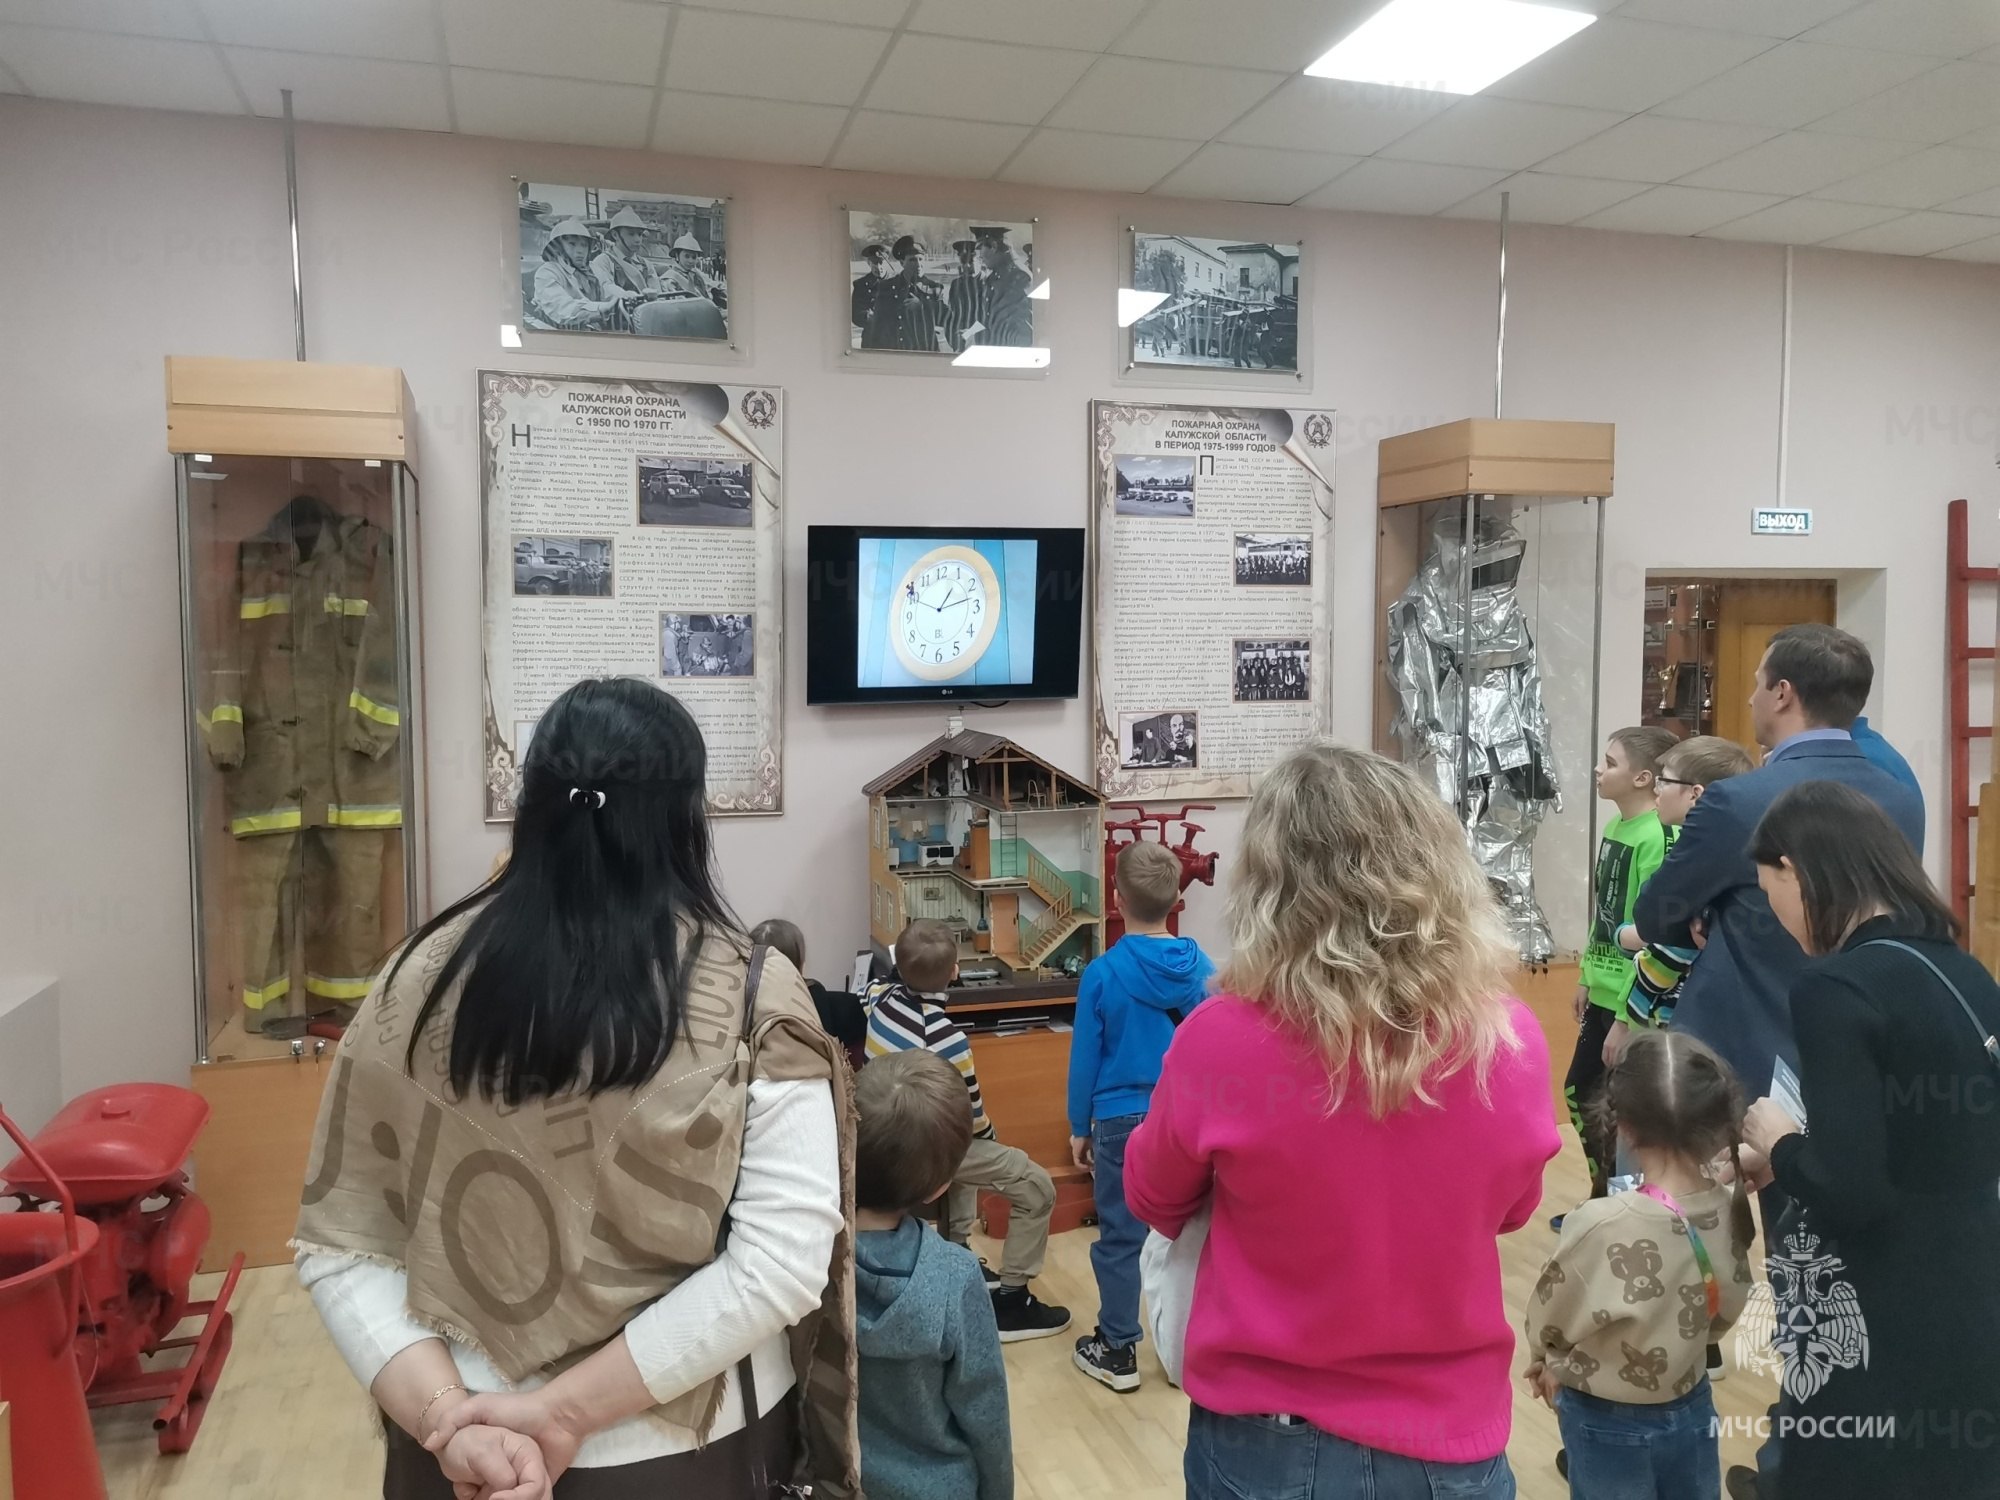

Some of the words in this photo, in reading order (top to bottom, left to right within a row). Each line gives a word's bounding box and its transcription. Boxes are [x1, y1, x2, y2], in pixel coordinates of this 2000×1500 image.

[568, 392, 633, 405] ПОЖАРНАЯ
[636, 396, 680, 408] ОХРАНА
[562, 403, 631, 417] КАЛУЖСКОЙ
[634, 408, 686, 420] ОБЛАСТИ
[576, 418, 583, 427] С
[587, 418, 611, 428] 1950
[614, 419, 630, 429] ПО
[633, 421, 657, 431] 1970
[660, 422, 674, 431] ГГ.
[1172, 420, 1223, 430] ПОЖАРНАЯ
[1226, 421, 1260, 431] ОХРАНА
[1165, 430, 1220, 441] КАЛУЖСКОЙ
[1224, 432, 1267, 442] ОБЛАСТИ
[1155, 441, 1161, 449] В
[1164, 441, 1201, 451] ПЕРИОД
[1203, 442, 1244, 452] 1975-1999
[1247, 443, 1276, 453] ГОДОВ
[1760, 513, 1806, 530] ВЫХОД
[935, 566, 948, 581] 12
[956, 567, 961, 580] 1
[920, 574, 931, 587] 11
[968, 578, 976, 592] 2
[908, 592, 920, 605] 10
[973, 599, 981, 615] 3
[906, 611, 913, 624] 9
[966, 623, 975, 638] 4
[909, 630, 915, 643] 8
[952, 641, 960, 656] 5
[920, 644, 927, 658] 7
[935, 648, 943, 663] 6
